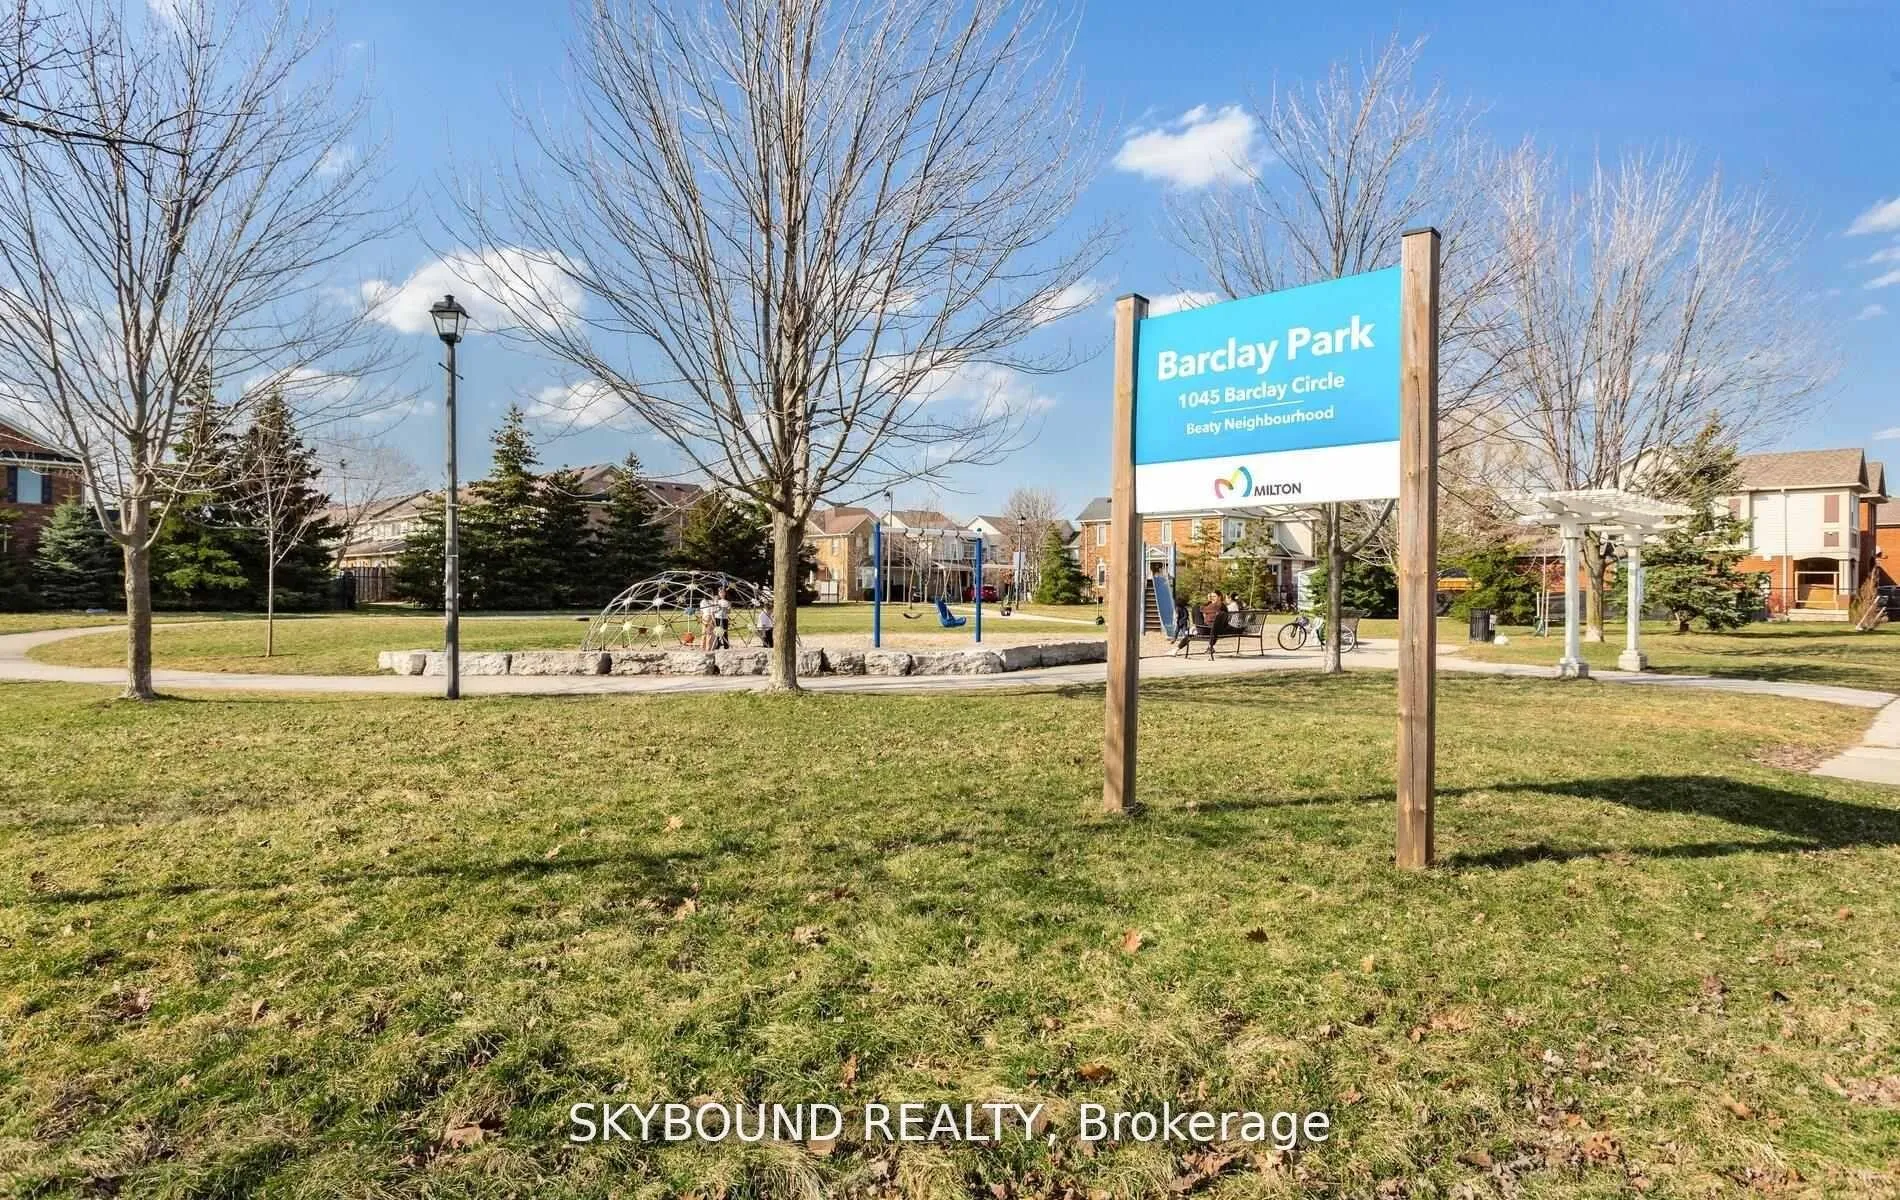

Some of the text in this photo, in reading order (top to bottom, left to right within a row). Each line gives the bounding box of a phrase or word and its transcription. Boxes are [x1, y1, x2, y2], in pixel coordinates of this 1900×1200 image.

[1157, 315, 1376, 381] Barclay Park
[1178, 371, 1345, 409] 1045 Barclay Circle
[1186, 405, 1334, 436] Beaty Neighbourhood
[1254, 482, 1302, 498] MILTON
